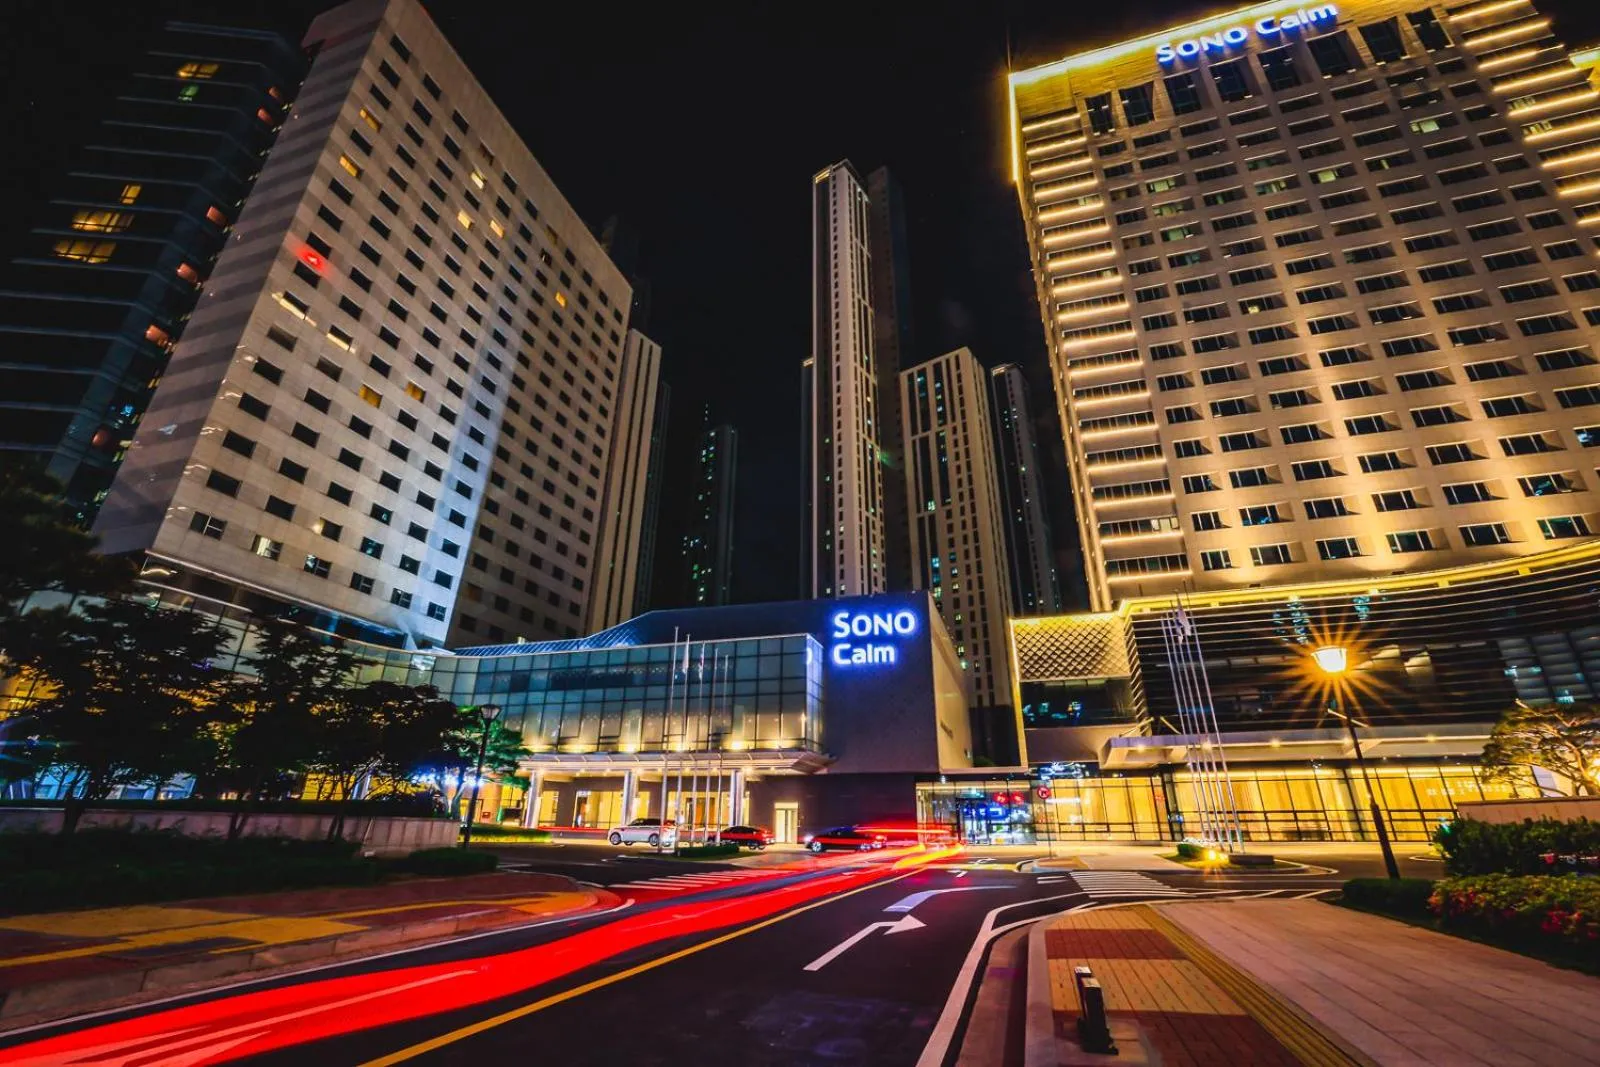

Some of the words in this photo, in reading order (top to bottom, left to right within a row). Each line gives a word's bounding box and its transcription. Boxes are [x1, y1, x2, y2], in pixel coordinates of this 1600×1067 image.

[1155, 26, 1248, 65] SONO
[1255, 4, 1339, 37] Calm
[833, 611, 916, 638] SONO
[833, 643, 896, 665] Calm
